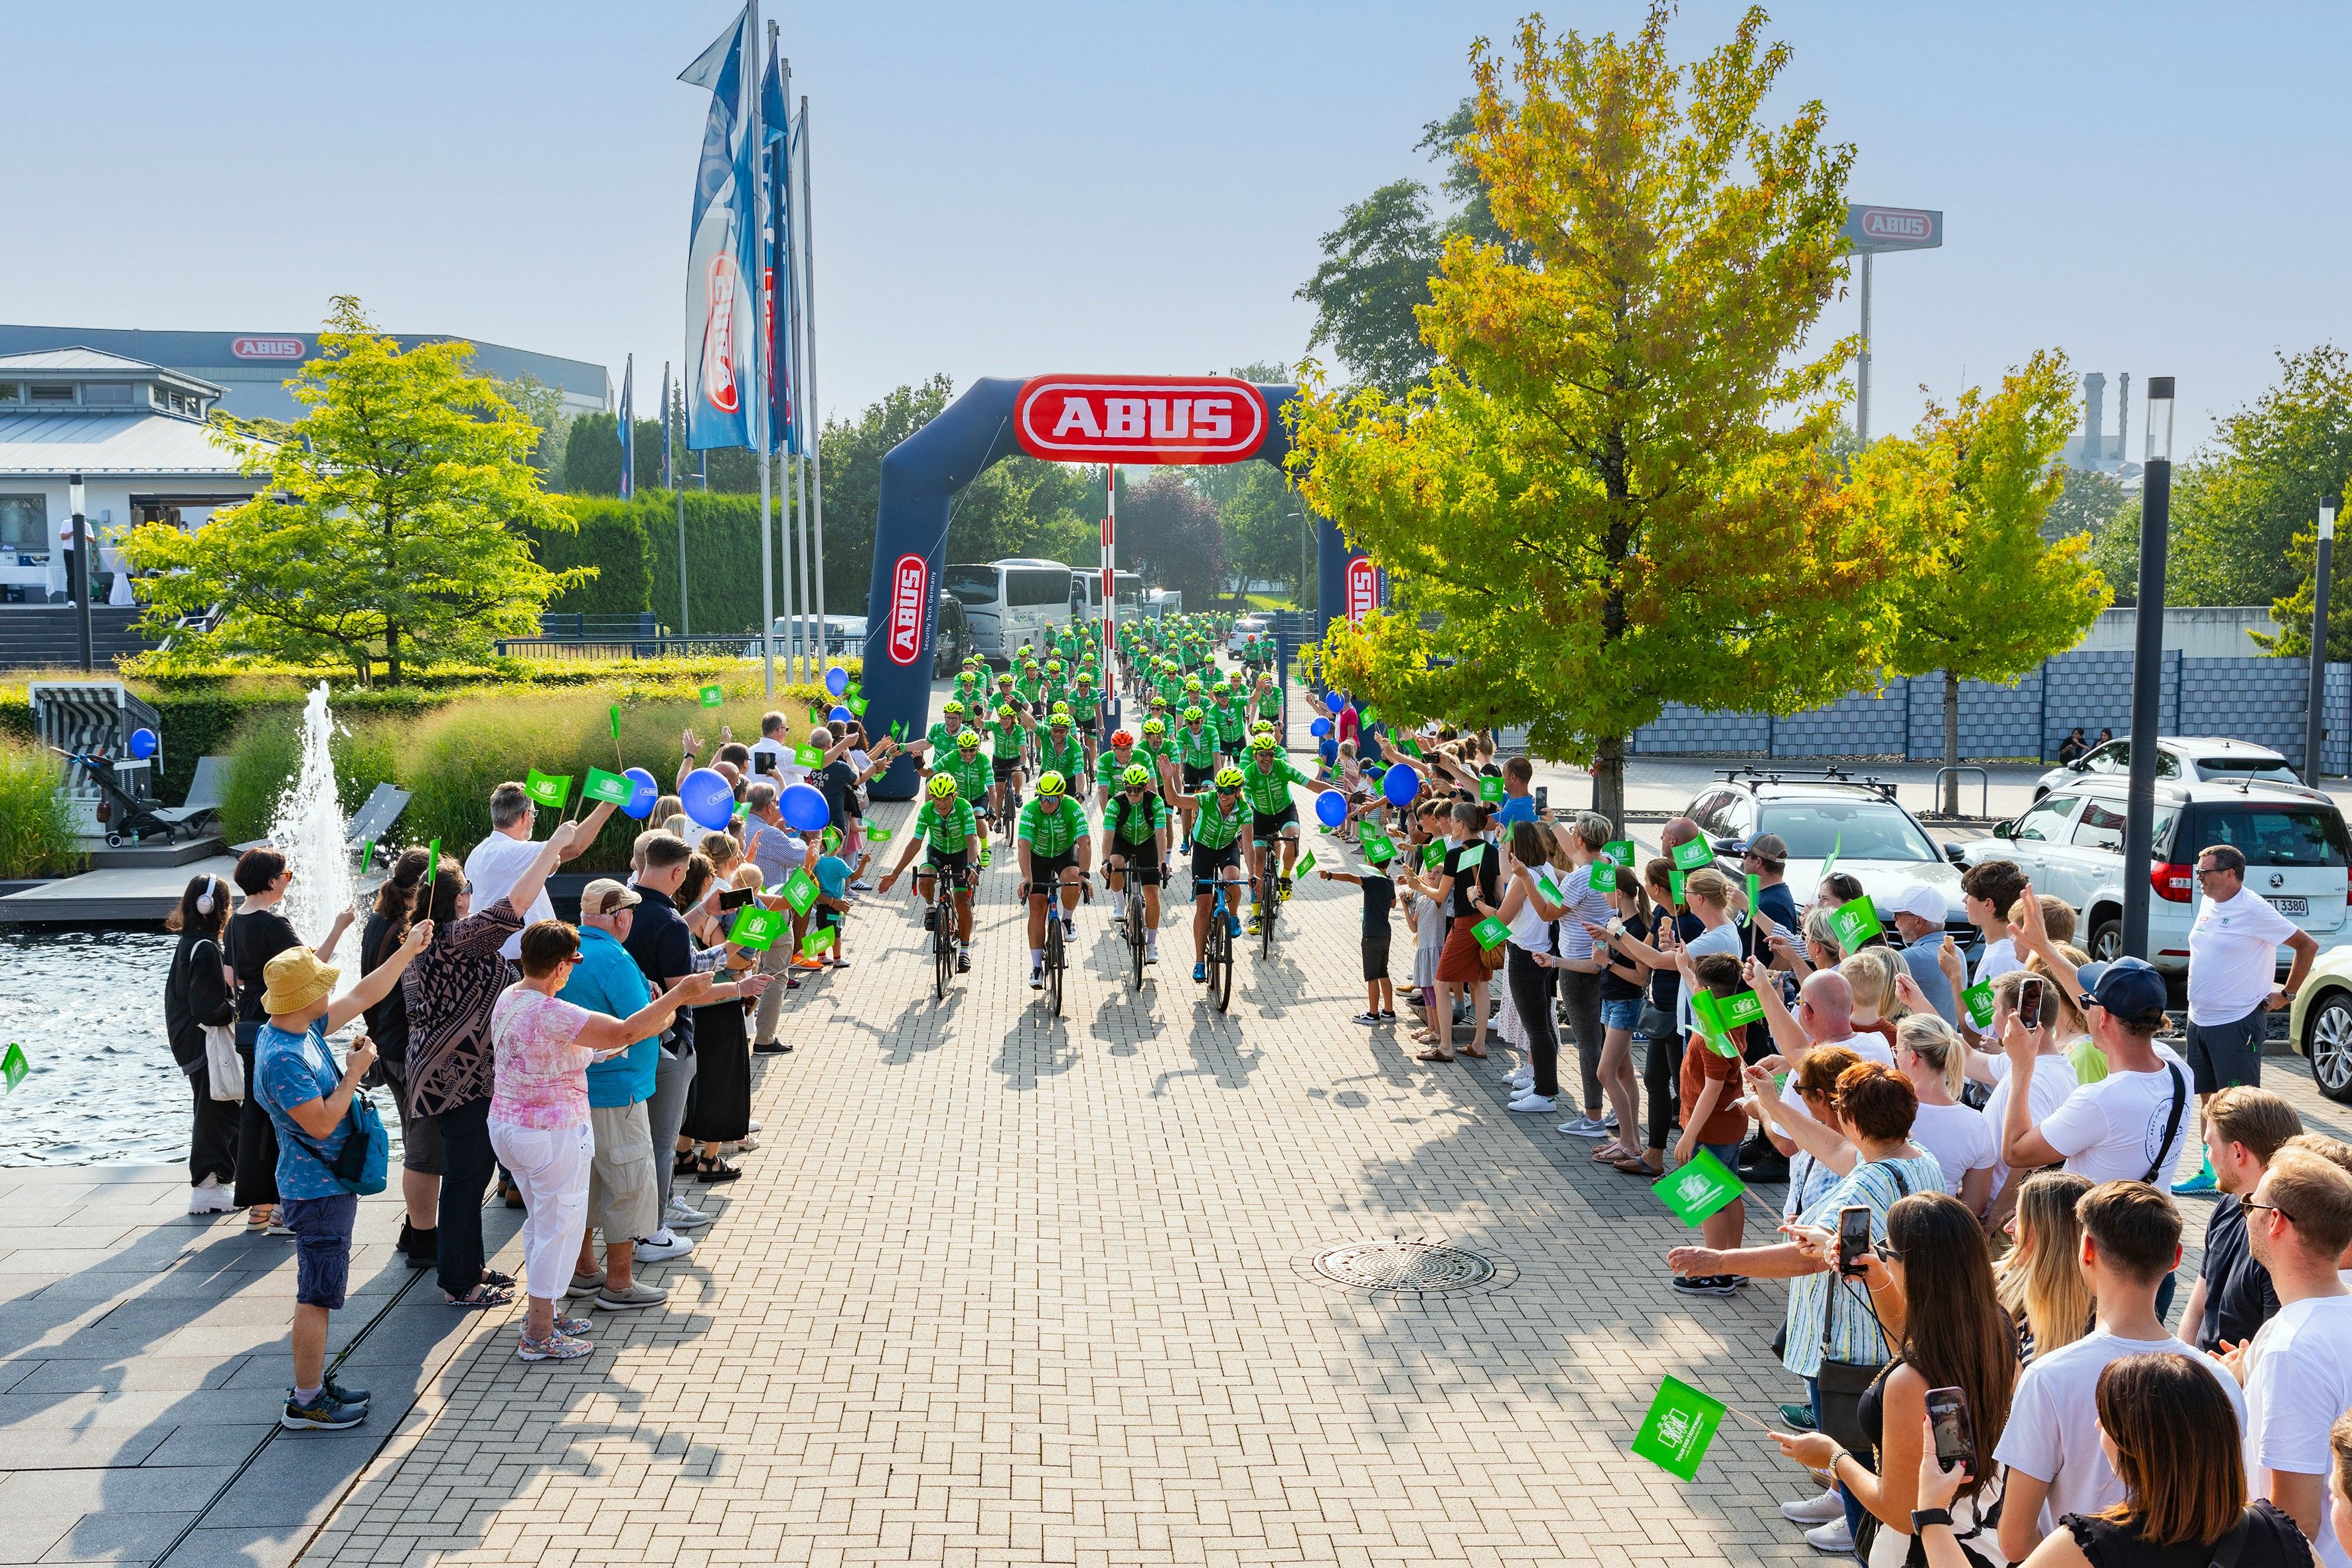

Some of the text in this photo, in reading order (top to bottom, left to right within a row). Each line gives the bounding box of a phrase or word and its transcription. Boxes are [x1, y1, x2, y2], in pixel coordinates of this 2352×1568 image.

[1871, 215, 1924, 234] ABUS
[241, 341, 296, 354] ABUS
[1052, 397, 1232, 439] ABUS
[928, 572, 937, 604] Germany
[896, 569, 920, 650] ABUS
[807, 771, 830, 781] 924
[804, 779, 824, 788] 024
[712, 789, 730, 803] ABUS
[2280, 900, 2305, 911] 3380
[1686, 1411, 1703, 1439] HOFFNUNG
[1682, 1437, 1691, 1449] DER
[1674, 1447, 1686, 1462] TOUR
